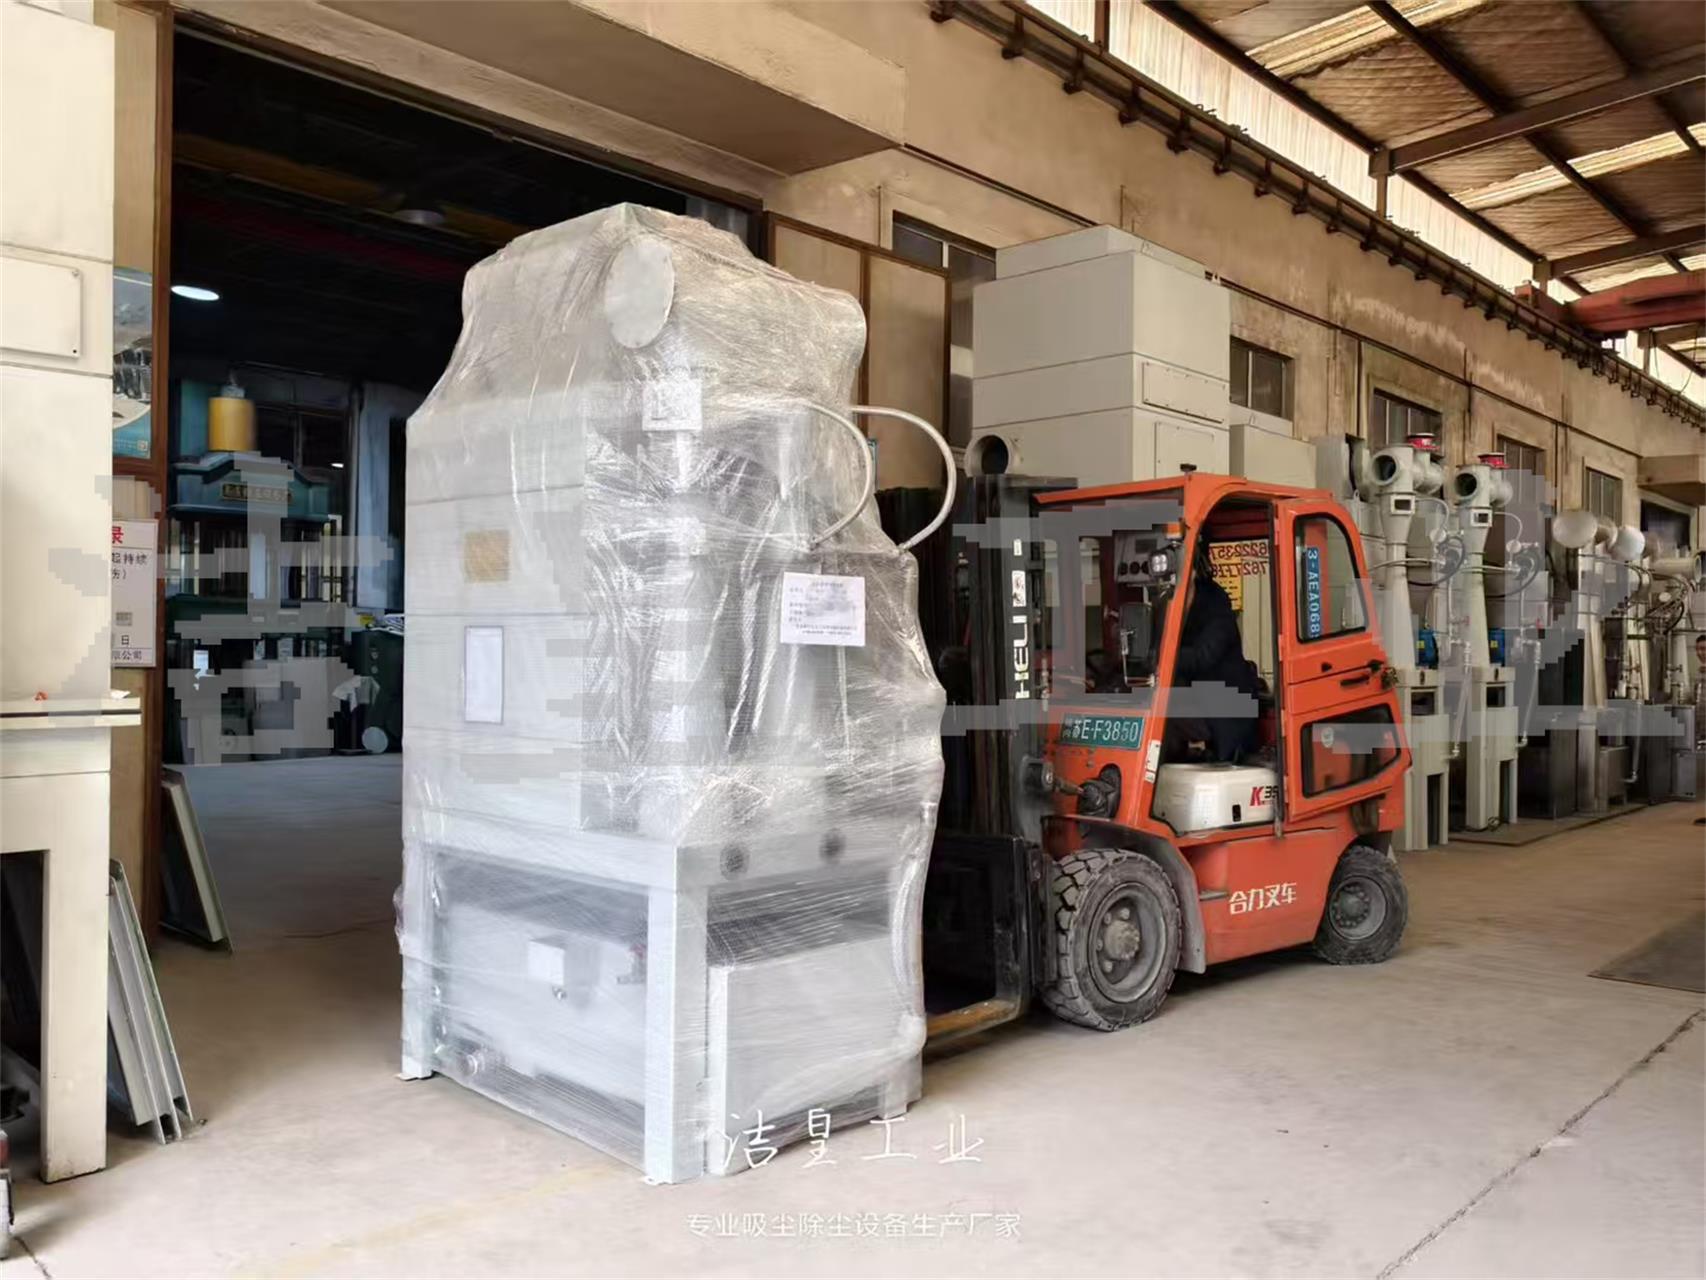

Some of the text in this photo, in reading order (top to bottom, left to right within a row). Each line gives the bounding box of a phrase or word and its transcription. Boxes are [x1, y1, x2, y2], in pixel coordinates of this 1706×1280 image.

[1014, 615, 1030, 700] HELI
[1229, 882, 1297, 915] 合力叉车
